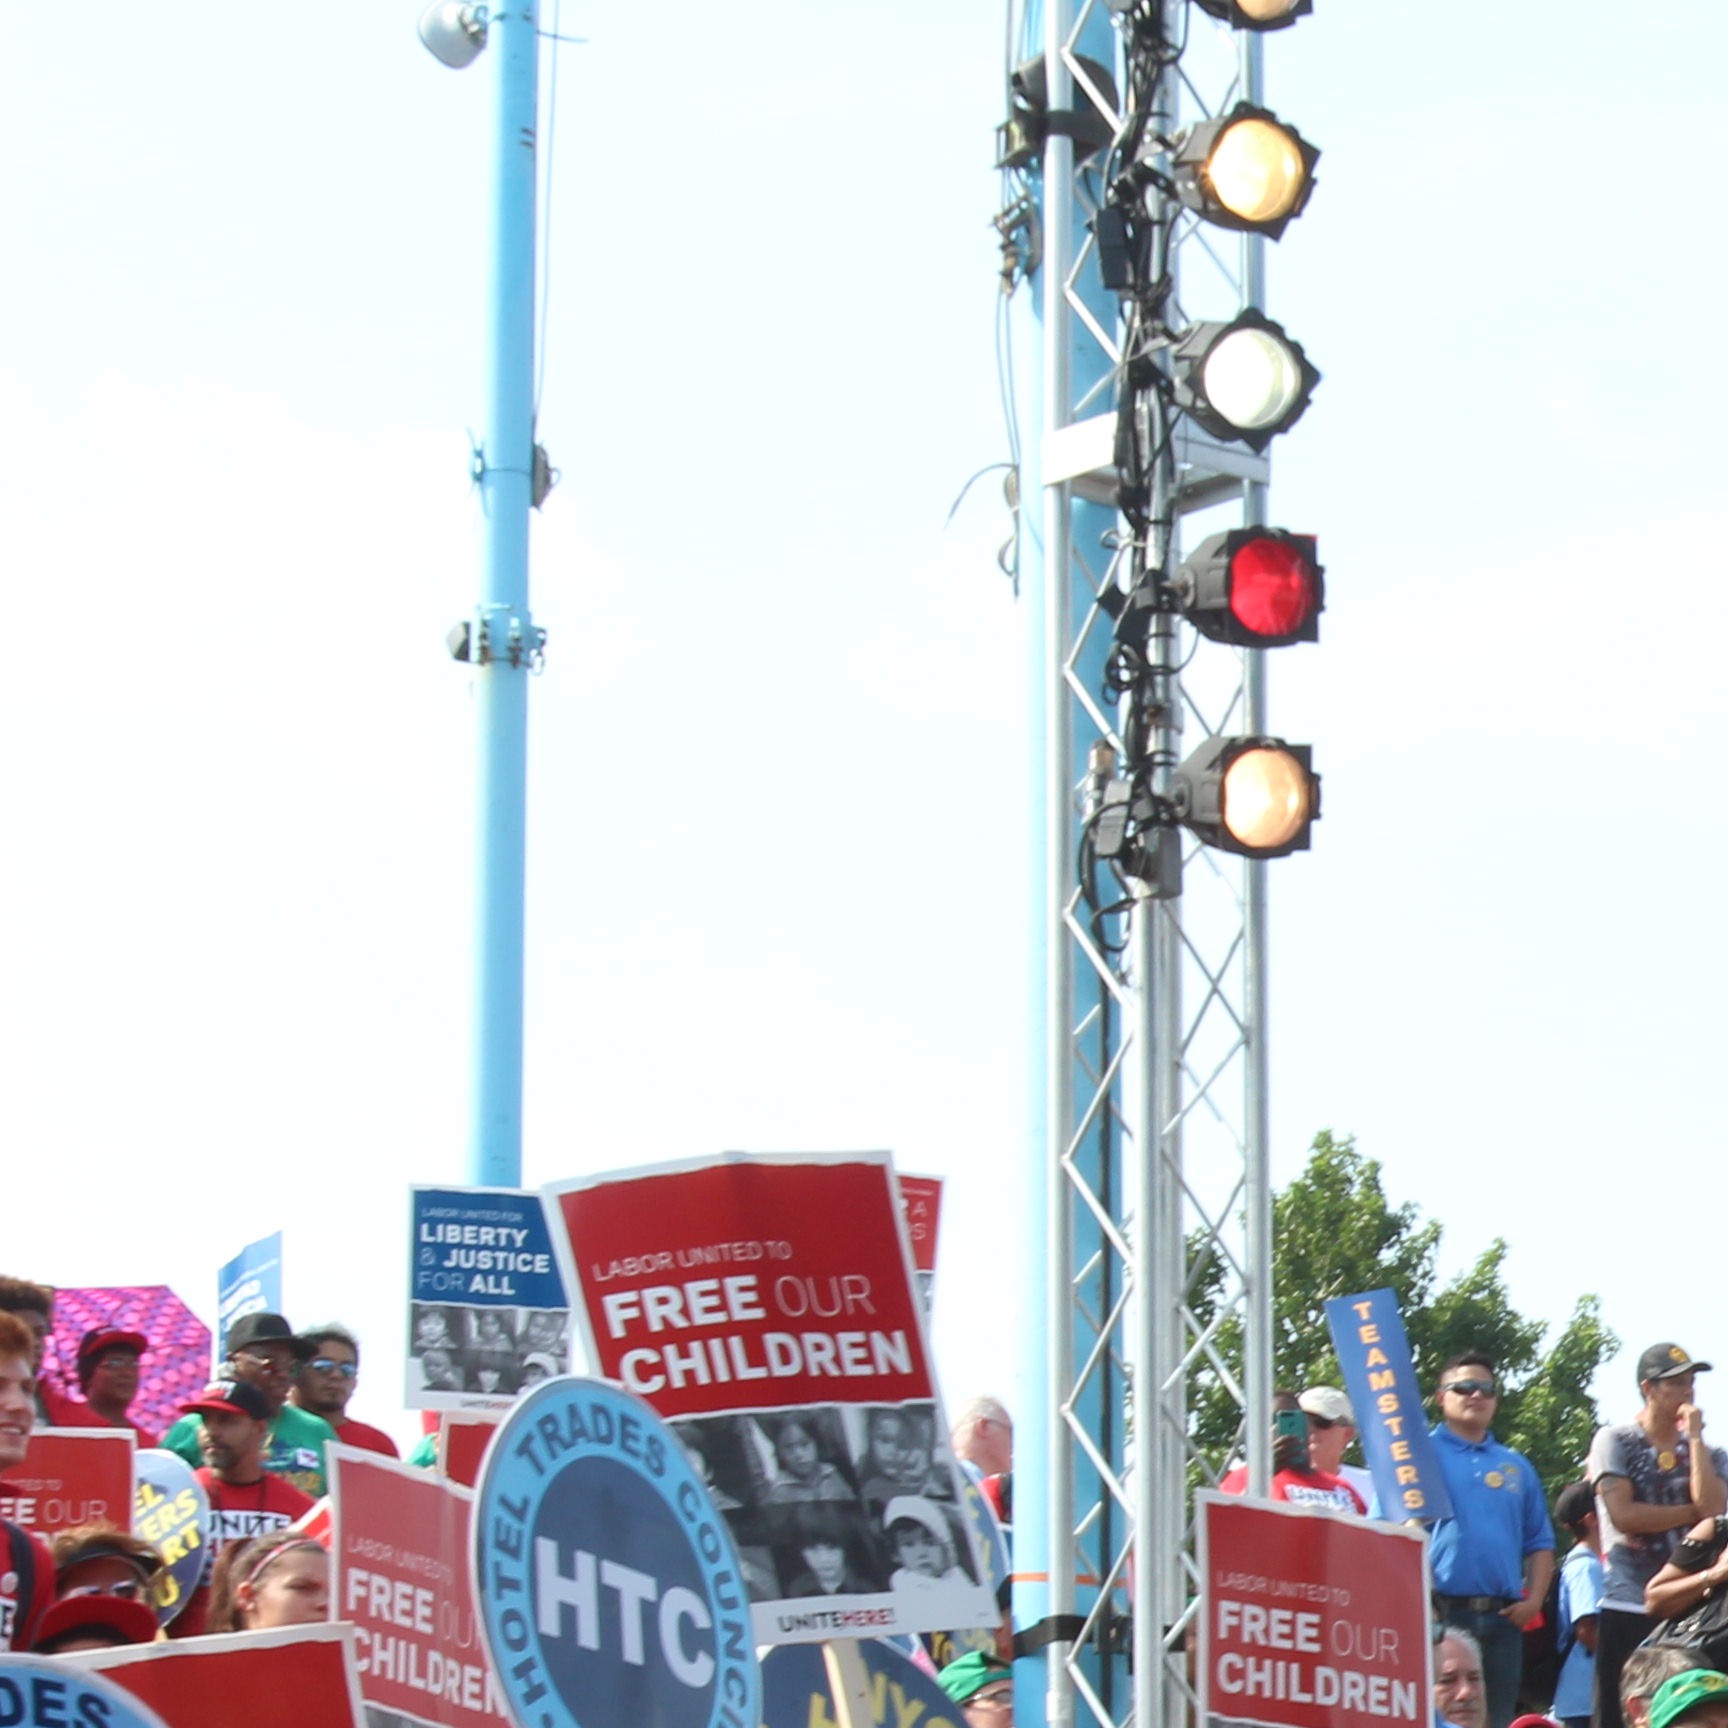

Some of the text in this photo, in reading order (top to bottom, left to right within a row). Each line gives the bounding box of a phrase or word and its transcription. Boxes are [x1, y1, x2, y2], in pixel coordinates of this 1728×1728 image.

[420, 1223, 528, 1248] LIBERTY
[422, 1207, 524, 1222] LABOR UNITED FOR
[417, 1271, 516, 1296] FOR ALL
[442, 1249, 550, 1274] JUSTICE
[592, 1241, 792, 1282] LABOR UNITED TO
[601, 1275, 877, 1339] FREE OUR
[619, 1330, 913, 1394] CHILDREN
[1352, 1300, 1426, 1510] TEAMSTERS
[513, 1401, 669, 1480] TRADES
[0, 1499, 108, 1525] EE OUR
[347, 1567, 480, 1651] FREE OU
[491, 1492, 547, 1708] HOTEL
[534, 1536, 716, 1689] HTC
[1217, 1570, 1350, 1606] LABOR UNITED TO
[1217, 1600, 1400, 1664] FREE OUR
[354, 1626, 509, 1718] CHILDREN
[1216, 1652, 1418, 1720] CHILDREN
